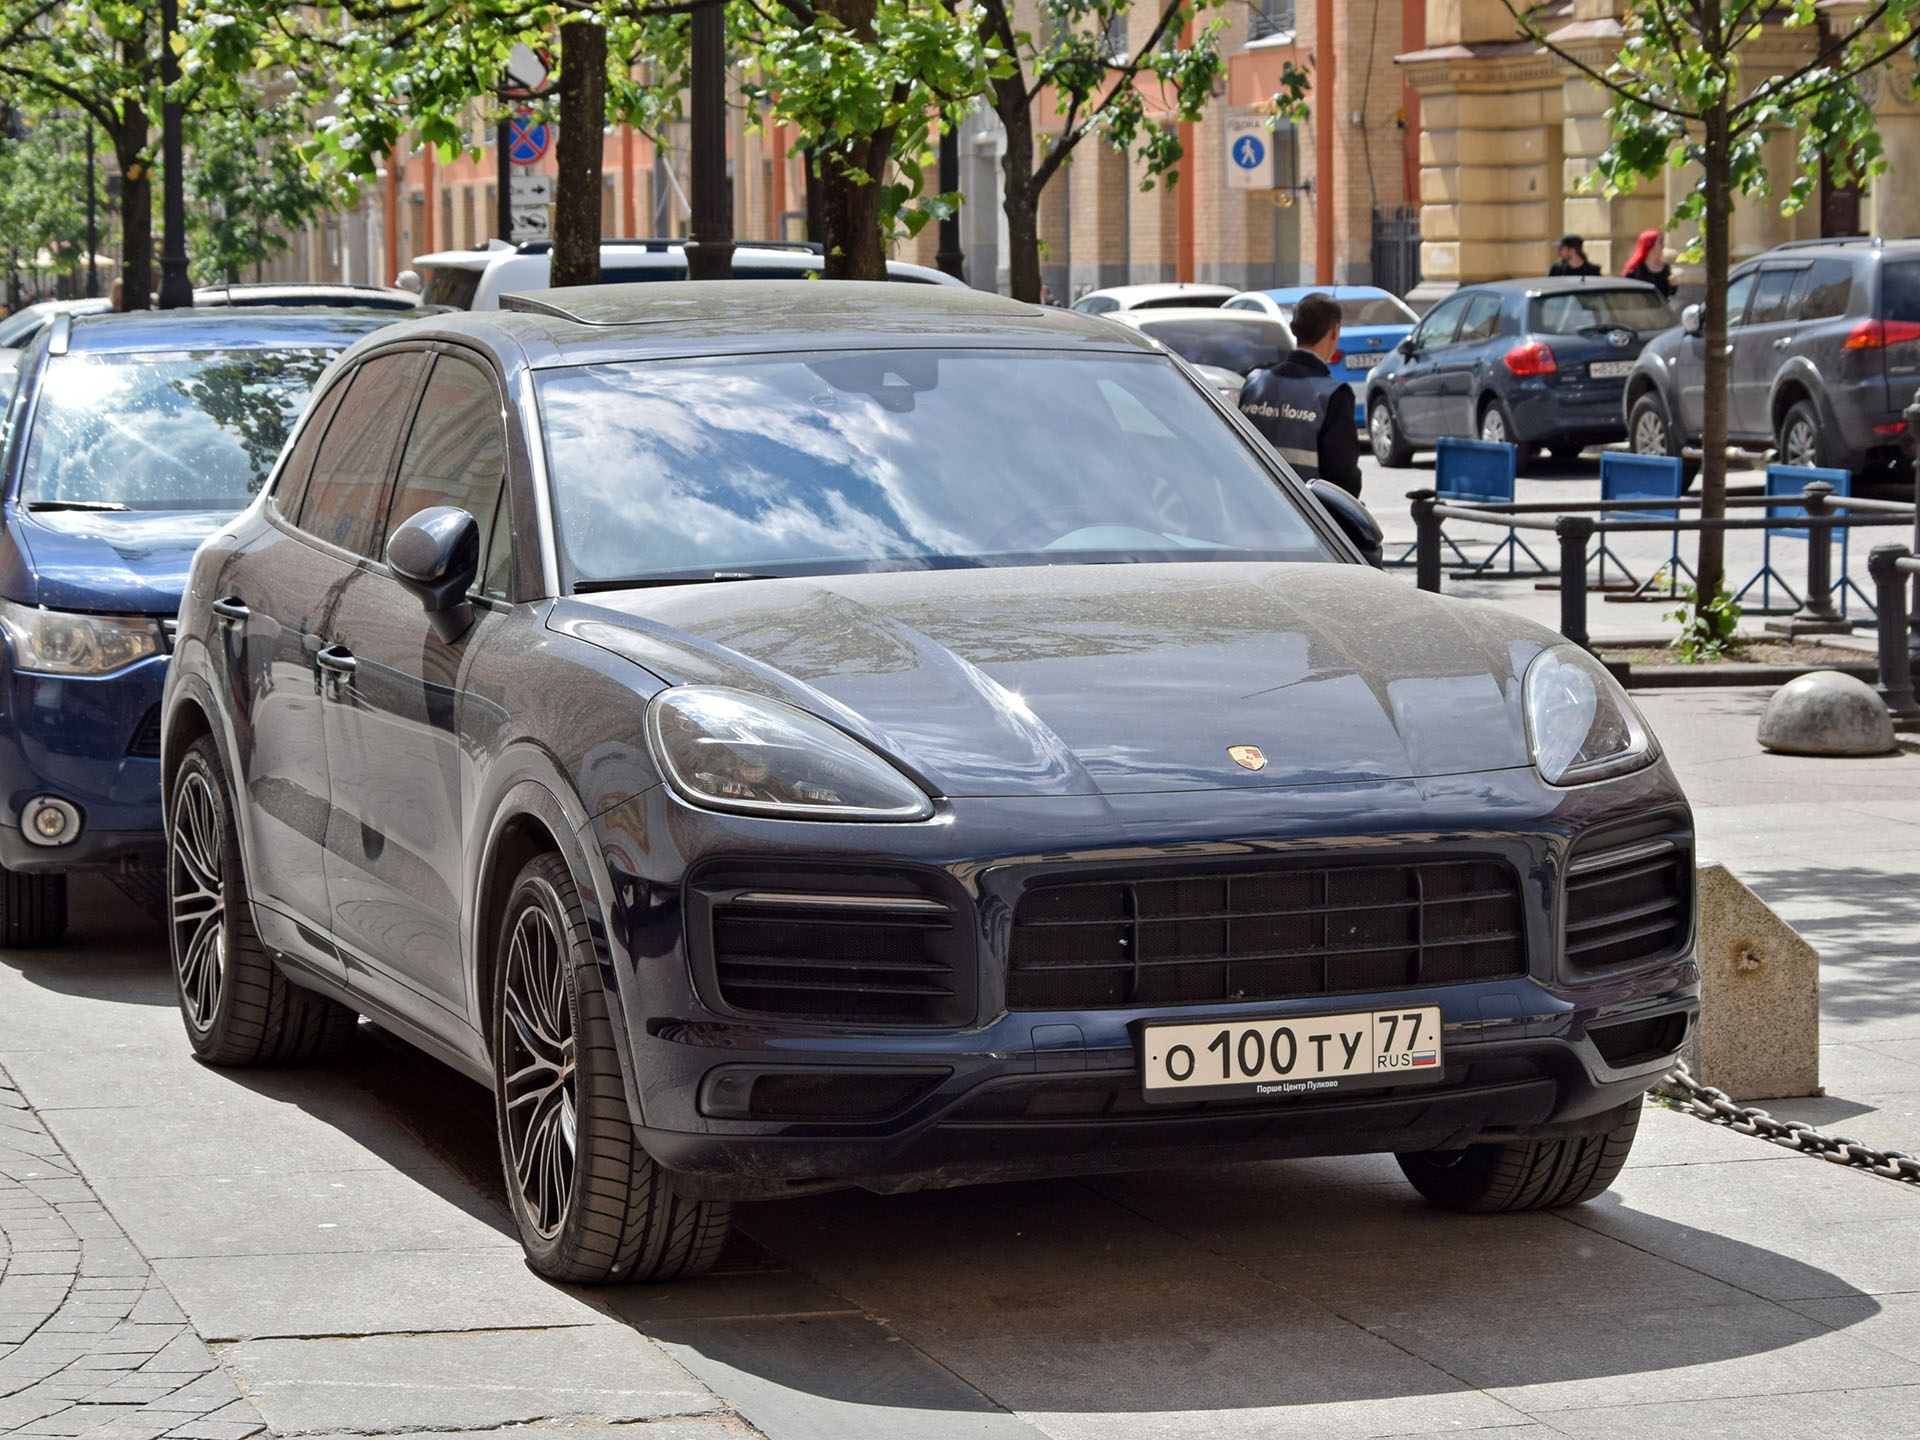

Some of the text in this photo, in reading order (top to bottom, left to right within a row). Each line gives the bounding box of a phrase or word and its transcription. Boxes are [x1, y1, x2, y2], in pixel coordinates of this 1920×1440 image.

[1281, 403, 1317, 422] House
[1378, 1013, 1422, 1053] 77
[1377, 1052, 1410, 1069] RUS
[1256, 1080, 1338, 1095] Порше Центр Пулково
